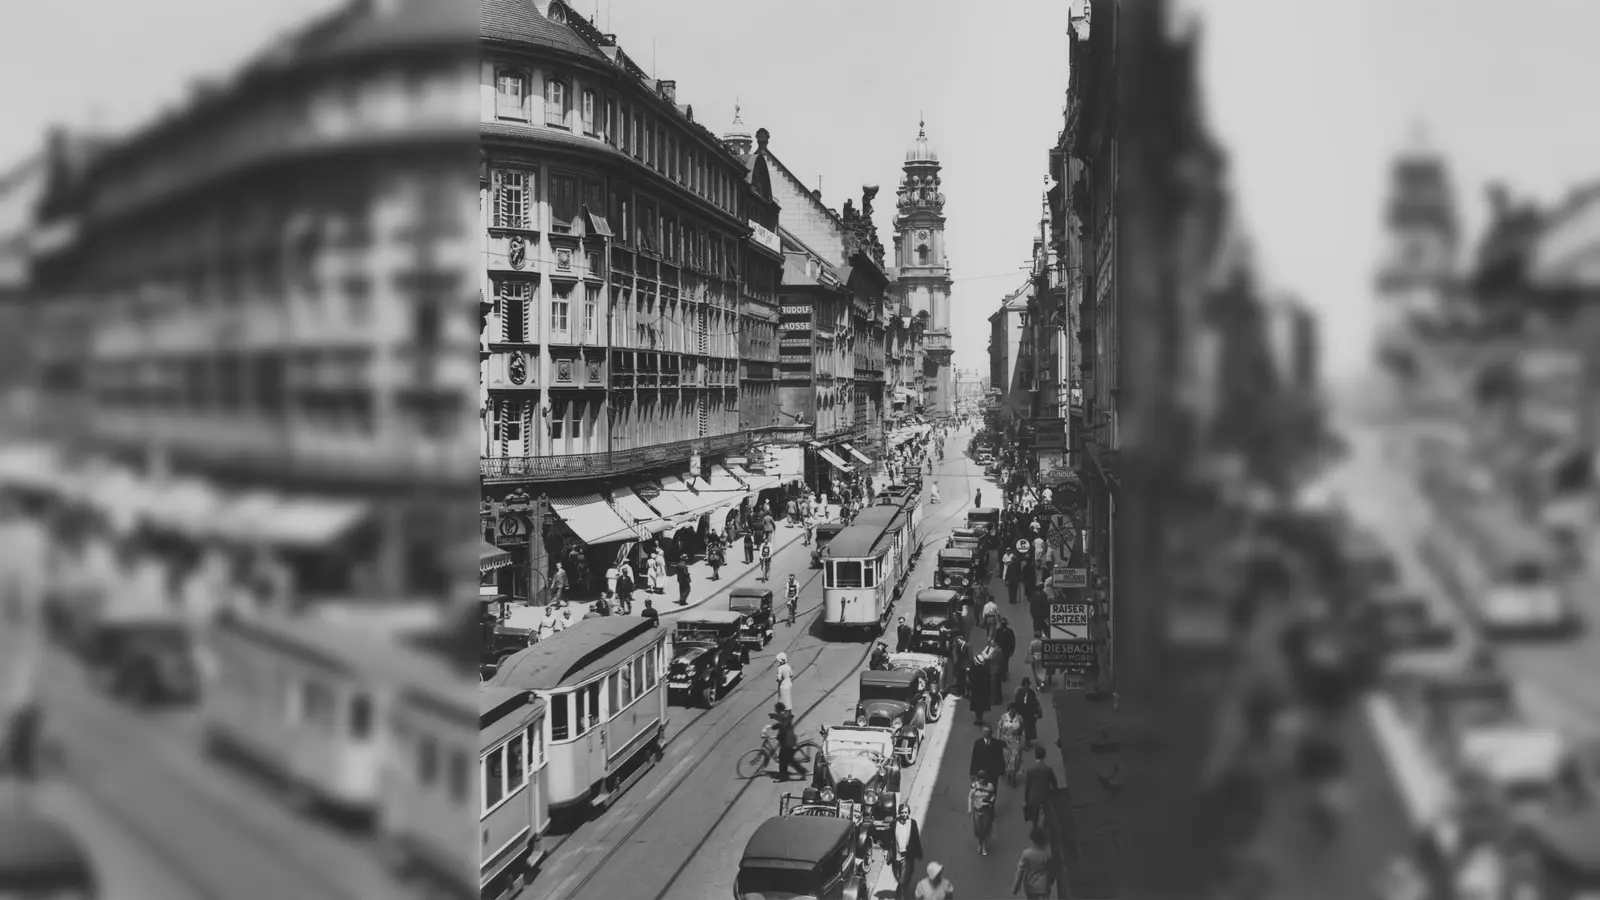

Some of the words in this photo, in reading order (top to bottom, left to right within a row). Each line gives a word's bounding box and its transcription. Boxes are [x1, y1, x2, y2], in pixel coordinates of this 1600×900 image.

[781, 305, 810, 314] RUDOLF
[1052, 605, 1085, 613] RAISER
[1051, 614, 1087, 623] SPITZEN
[1043, 643, 1094, 654] DIESBACH
